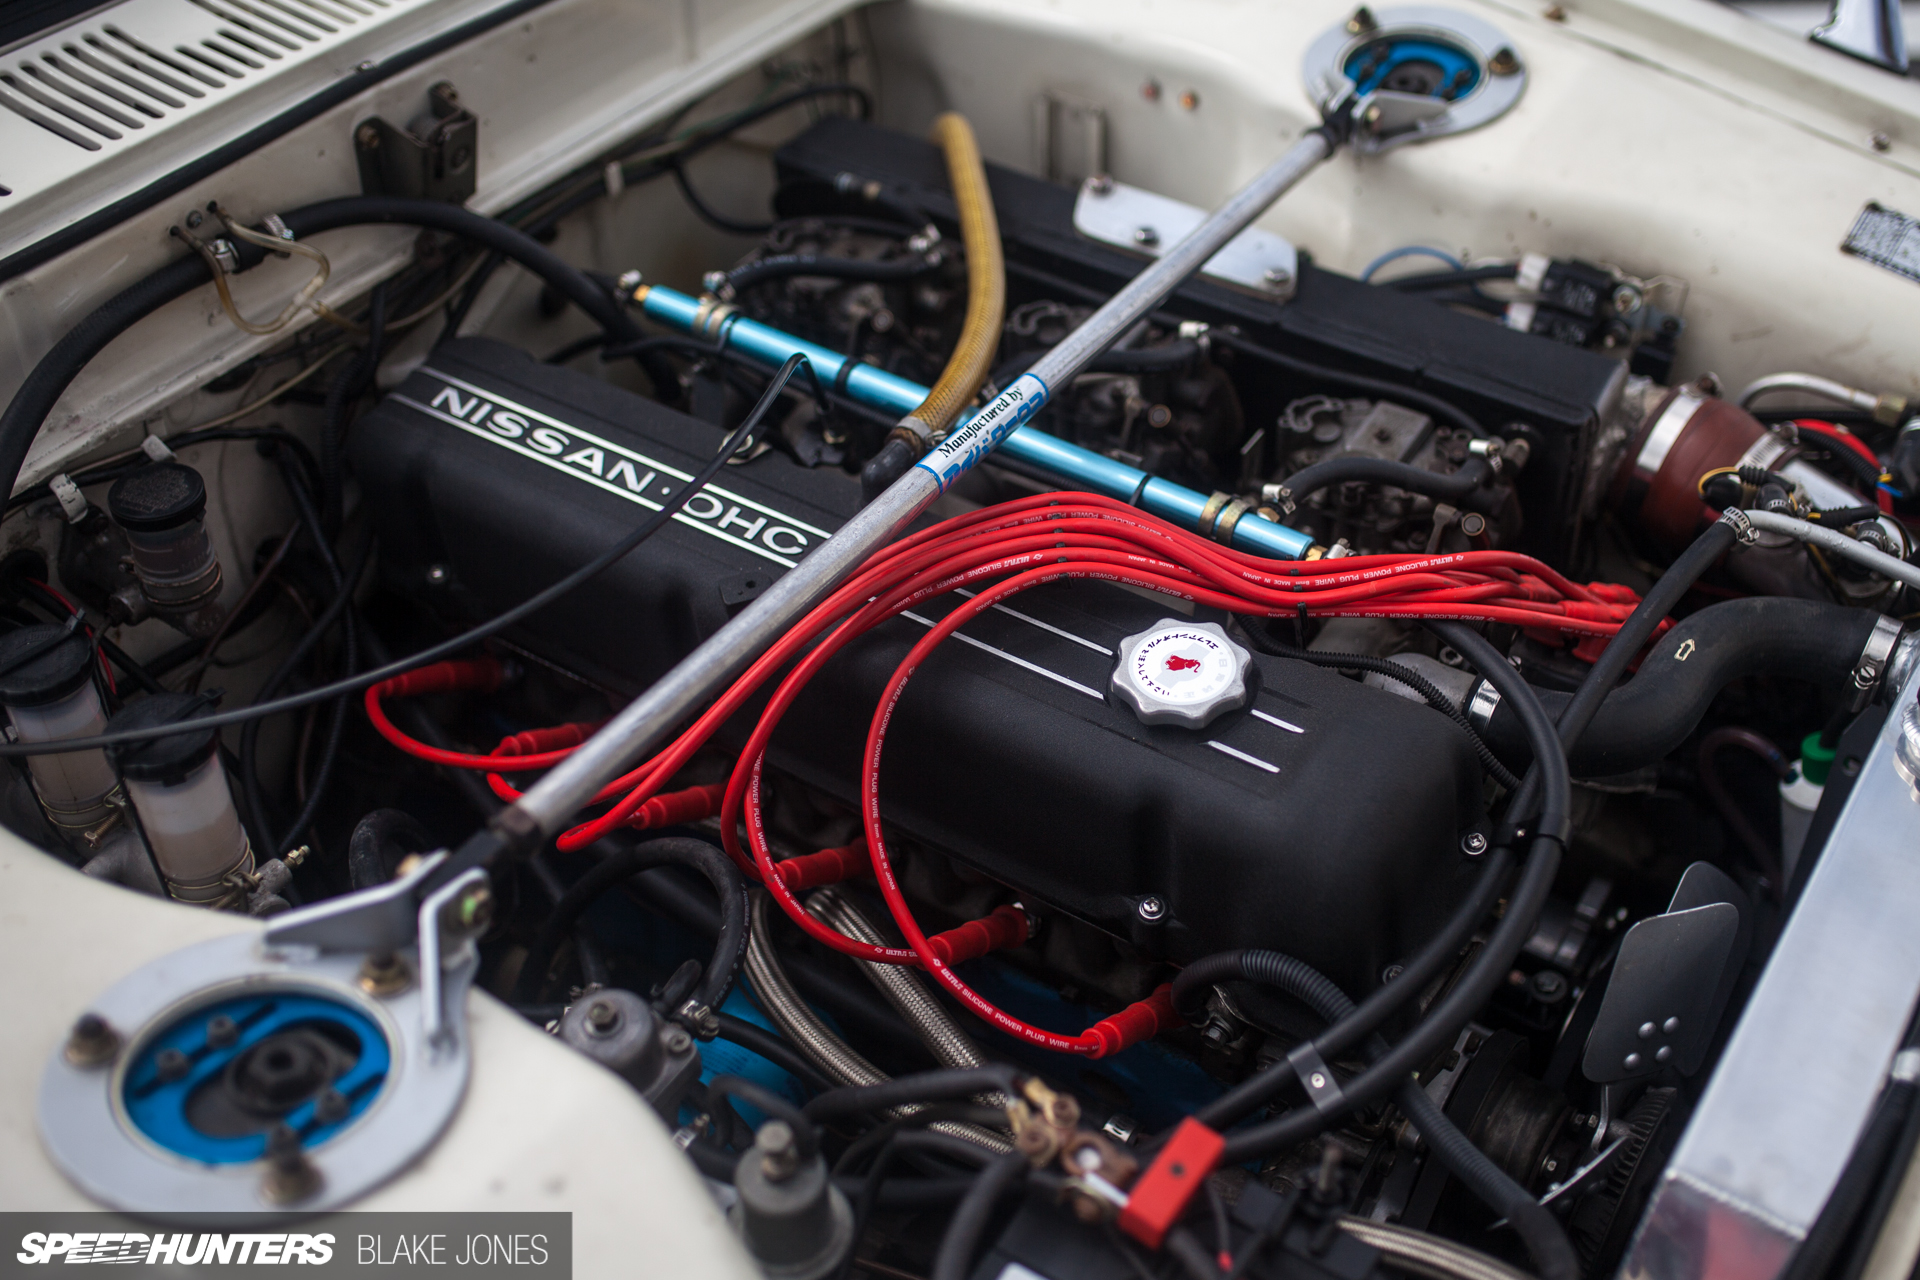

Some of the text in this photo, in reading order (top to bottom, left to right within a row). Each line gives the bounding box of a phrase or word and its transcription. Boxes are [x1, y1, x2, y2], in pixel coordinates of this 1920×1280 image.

[938, 386, 1024, 458] Manufactured by
[430, 385, 810, 556] NISSAN OHC
[1023, 515, 1043, 525] WIRE
[1004, 555, 1030, 568] ULTRA
[1158, 561, 1175, 569] MADE
[1394, 560, 1429, 573] SILICONE
[1430, 556, 1453, 566] ULTRA
[967, 562, 1002, 578] SILICONE
[1089, 572, 1119, 581] POWER
[1242, 571, 1262, 581] JAPAN
[1363, 567, 1392, 579] POWER
[936, 574, 964, 589] POWER
[1120, 576, 1156, 590] SILICONE
[1314, 577, 1335, 586] WIRE
[1339, 574, 1360, 583] PLUG
[913, 586, 933, 599] PLUG
[1003, 586, 1019, 597] MADE
[1155, 585, 1182, 597] ULTRA
[975, 599, 993, 612] JAPAN
[892, 676, 908, 702] ULTRA
[879, 701, 896, 736] SILICONE
[873, 738, 883, 769] POWER
[871, 797, 879, 819] WIRE
[753, 807, 762, 828] PLUG
[757, 831, 768, 853] WIRE
[877, 842, 886, 860] MADE
[882, 861, 889, 869] IN
[773, 873, 785, 890] MADE
[885, 871, 896, 891] JAPAN
[784, 890, 791, 899] IN
[790, 898, 806, 916] JAPAN
[885, 948, 907, 957] ULTRA
[940, 968, 964, 991] ULTRA
[962, 988, 994, 1015] SILICONE
[994, 1012, 1023, 1033] POWER
[1025, 1029, 1046, 1042] PLUG
[1049, 1037, 1070, 1049] WIRE
